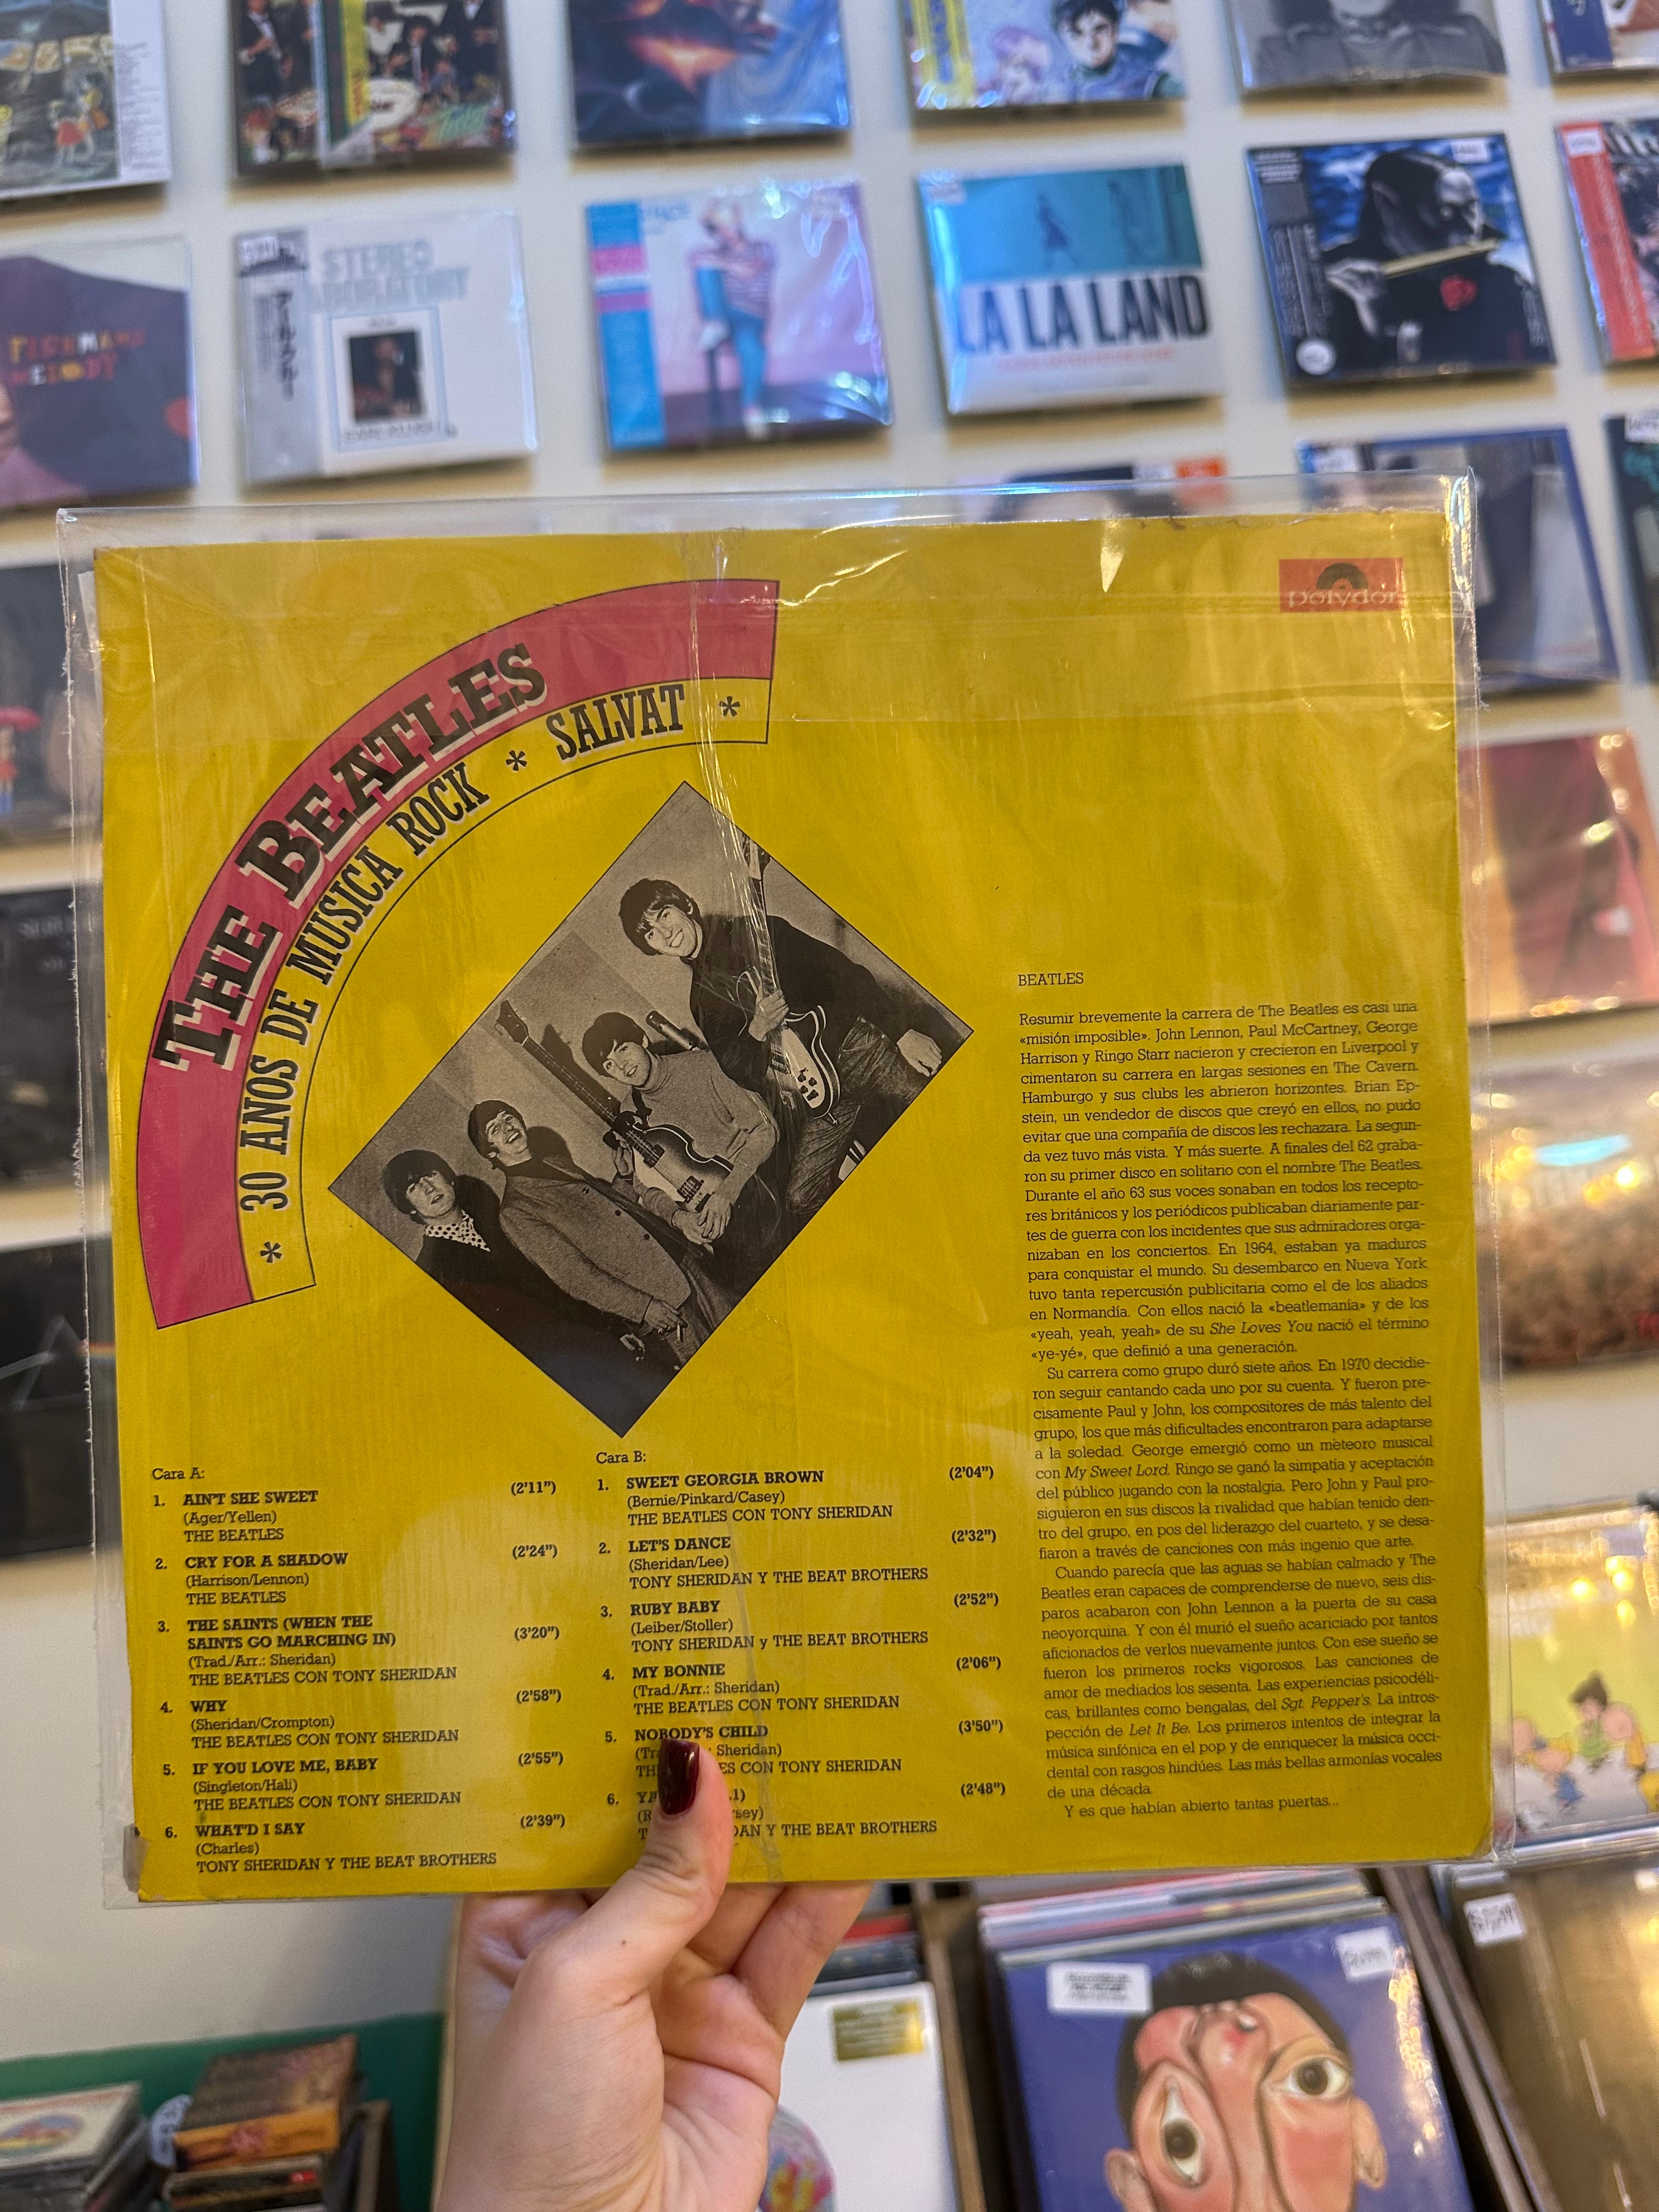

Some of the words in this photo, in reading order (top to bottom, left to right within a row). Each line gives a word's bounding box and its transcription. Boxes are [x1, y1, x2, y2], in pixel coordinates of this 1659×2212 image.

[1021, 282, 1079, 350] LA
[1088, 275, 1210, 343] LAND
[1289, 589, 1398, 607] polydor
[545, 683, 685, 760] SALVAT
[386, 763, 489, 856] ROCK
[154, 905, 282, 1070] THE
[236, 642, 547, 906] BEATLES
[286, 846, 404, 986] MUSICA
[1017, 972, 1085, 986] BEATLES
[260, 988, 319, 1046] DE
[1018, 1012, 1075, 1026] Resumir
[1077, 1009, 1163, 1024] brevemente
[1165, 1008, 1178, 1020] la
[1181, 1009, 1233, 1020] carrera
[1235, 1005, 1255, 1018] de
[1257, 1005, 1285, 1017] The
[1289, 1002, 1340, 1016] Beatles
[1342, 1005, 1360, 1014] es
[1361, 1000, 1390, 1014] casi
[1392, 1002, 1419, 1013] una
[1019, 1031, 1071, 1045] «misión
[1073, 1029, 1152, 1045] imposible».
[1154, 1028, 1187, 1043] John
[1189, 1026, 1244, 1040] Lennon,
[1247, 1024, 1278, 1037] Paul
[1281, 1023, 1362, 1037] McCartney,
[1365, 1020, 1419, 1035] George
[240, 1054, 300, 1155] ANOS
[239, 1171, 290, 1211] 30
[1026, 1248, 1081, 1261] nizaban
[1086, 1249, 1105, 1260] en
[1110, 1246, 1131, 1259] los
[1136, 1244, 1211, 1258] conciertos.
[1217, 1243, 1238, 1255] En
[1244, 1241, 1277, 1255] 1964,
[1283, 1240, 1339, 1254] estaban
[1344, 1242, 1362, 1254] ya
[1367, 1237, 1427, 1251] maduros
[1030, 1327, 1074, 1342] «yeah,
[1078, 1325, 1116, 1341] yeah,
[1120, 1324, 1161, 1340] yeah»
[1165, 1323, 1186, 1336] de
[1188, 1325, 1205, 1336] su
[1209, 1322, 1236, 1335] She
[1240, 1321, 1282, 1334] Loves
[1286, 1319, 1313, 1333] You
[1316, 1318, 1355, 1332] nació
[1358, 1318, 1373, 1331] el
[1376, 1317, 1430, 1330] término
[595, 1451, 630, 1465] Cara
[633, 1450, 647, 1463] B:
[150, 1468, 187, 1481] Cara
[189, 1466, 206, 1480] A:
[597, 1479, 610, 1491] 1.
[625, 1475, 680, 1489] SWEET
[684, 1472, 760, 1487] GEORGIA
[763, 1470, 825, 1484] BROWN
[153, 1494, 166, 1508] 1.
[182, 1493, 227, 1506] AIN'T
[229, 1492, 261, 1505] SHE
[263, 1489, 319, 1504] SWEET
[627, 1489, 786, 1510] (Bernie/Pinkard/Casey)
[183, 1509, 277, 1527] (Ager/Yellen)
[598, 1542, 611, 1555] 2.
[628, 1539, 670, 1553] LET'S
[673, 1536, 732, 1551] DANCE
[154, 1557, 168, 1570] 2.
[184, 1556, 219, 1569] CRY
[222, 1555, 257, 1568] FOR
[259, 1555, 274, 1568] A
[277, 1552, 349, 1567] SHADOW
[628, 1555, 730, 1573] (Sheridan/Lee)
[185, 1572, 310, 1589] (Harrison/Lennon)
[600, 1605, 613, 1618] 3.
[629, 1602, 673, 1617] RUBY
[676, 1600, 721, 1614] BABY
[157, 1620, 170, 1633] 3.
[186, 1618, 219, 1632] THE
[222, 1617, 279, 1631] SAINTS
[283, 1616, 338, 1632] (WHEN
[340, 1615, 374, 1628] THE
[630, 1618, 734, 1637] (Leiber/Stoller)
[187, 1637, 244, 1651] SAINTS
[246, 1635, 273, 1649] GO
[276, 1633, 369, 1648] MARCHING
[372, 1632, 397, 1647] IN)
[188, 1655, 266, 1671] (Trad./Arr.:
[269, 1652, 336, 1667] Sheridan)
[602, 1668, 615, 1681] 4.
[631, 1666, 660, 1679] MY
[663, 1663, 726, 1678] BONNIE
[632, 1683, 710, 1700] (Trad./Arr.:
[714, 1679, 781, 1695] Sheridan)
[159, 1701, 173, 1714] 4.
[189, 1700, 228, 1713] WHY
[190, 1714, 336, 1733] (Sheridan/Crompton)
[605, 1730, 617, 1743] 5.
[718, 1725, 769, 1739] CHILD
[716, 1742, 782, 1757] Sheridan)
[162, 1763, 176, 1777] 5.
[191, 1762, 210, 1776] IF
[212, 1762, 247, 1775] YOU
[251, 1760, 296, 1774] LOVE
[298, 1759, 331, 1774] ME,
[334, 1757, 379, 1771] BABY
[636, 1765, 659, 1778] TH
[740, 1761, 774, 1775] CON
[777, 1760, 821, 1774] TONY
[826, 1758, 902, 1773] SHERIDAN
[606, 1792, 619, 1807] 6.
[1063, 1804, 1074, 1819] Y
[1079, 1807, 1096, 1818] es
[1099, 1805, 1126, 1819] que
[1130, 1801, 1177, 1815] habían
[1180, 1799, 1231, 1813] abierto
[1233, 1798, 1274, 1811] tantas
[164, 1826, 178, 1839] 6.
[262, 1823, 270, 1836] I
[274, 1822, 306, 1836] SAY
[765, 1824, 777, 1837] Y
[781, 1823, 811, 1837] THE
[815, 1822, 856, 1836] BEAT
[859, 1820, 938, 1835] BROTHERS
[195, 1841, 260, 1858] (Charles)
[195, 1859, 240, 1874] TONY
[243, 1858, 321, 1872] SHERIDAN
[324, 1857, 337, 1870] Y
[339, 1856, 371, 1870] THE
[374, 1855, 416, 1869] BEAT
[418, 1852, 498, 1867] BROTHERS
